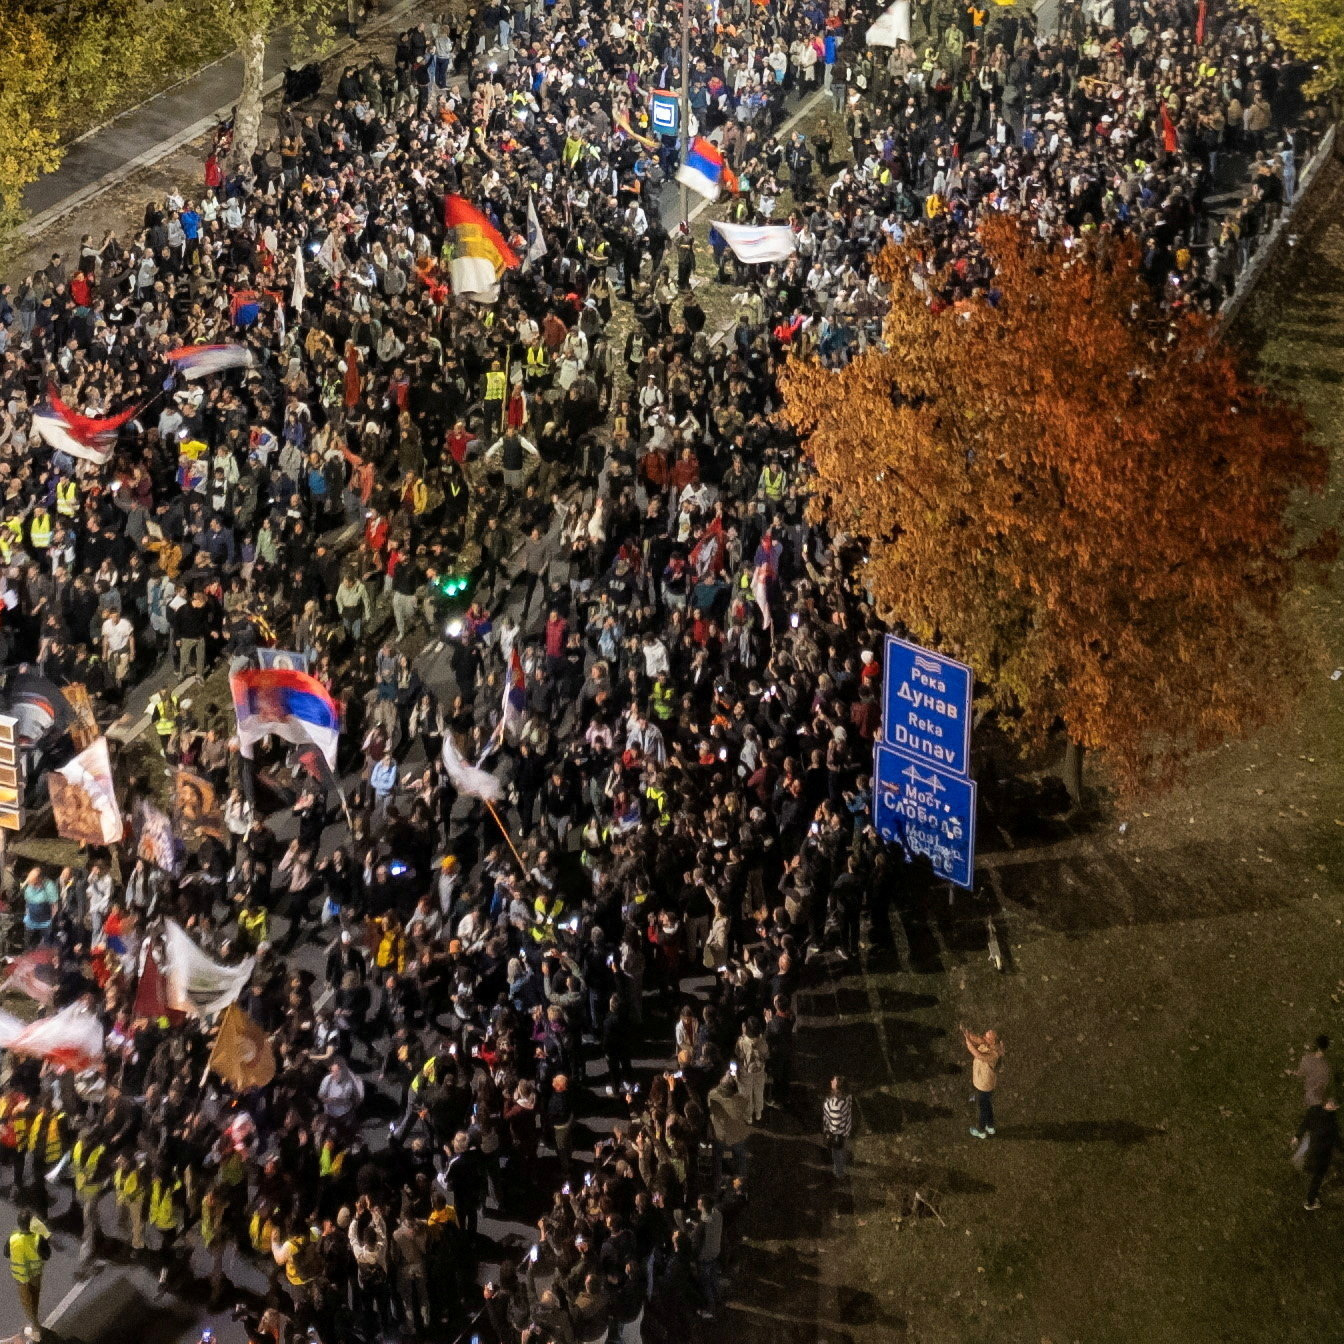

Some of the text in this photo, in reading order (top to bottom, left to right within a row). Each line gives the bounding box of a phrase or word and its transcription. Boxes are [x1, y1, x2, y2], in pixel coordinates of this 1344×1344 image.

[911, 667, 946, 693] Река
[897, 681, 958, 719] Дунав
[908, 711, 943, 737] Reka
[895, 723, 956, 763] Dunav
[905, 783, 942, 810] Мост
